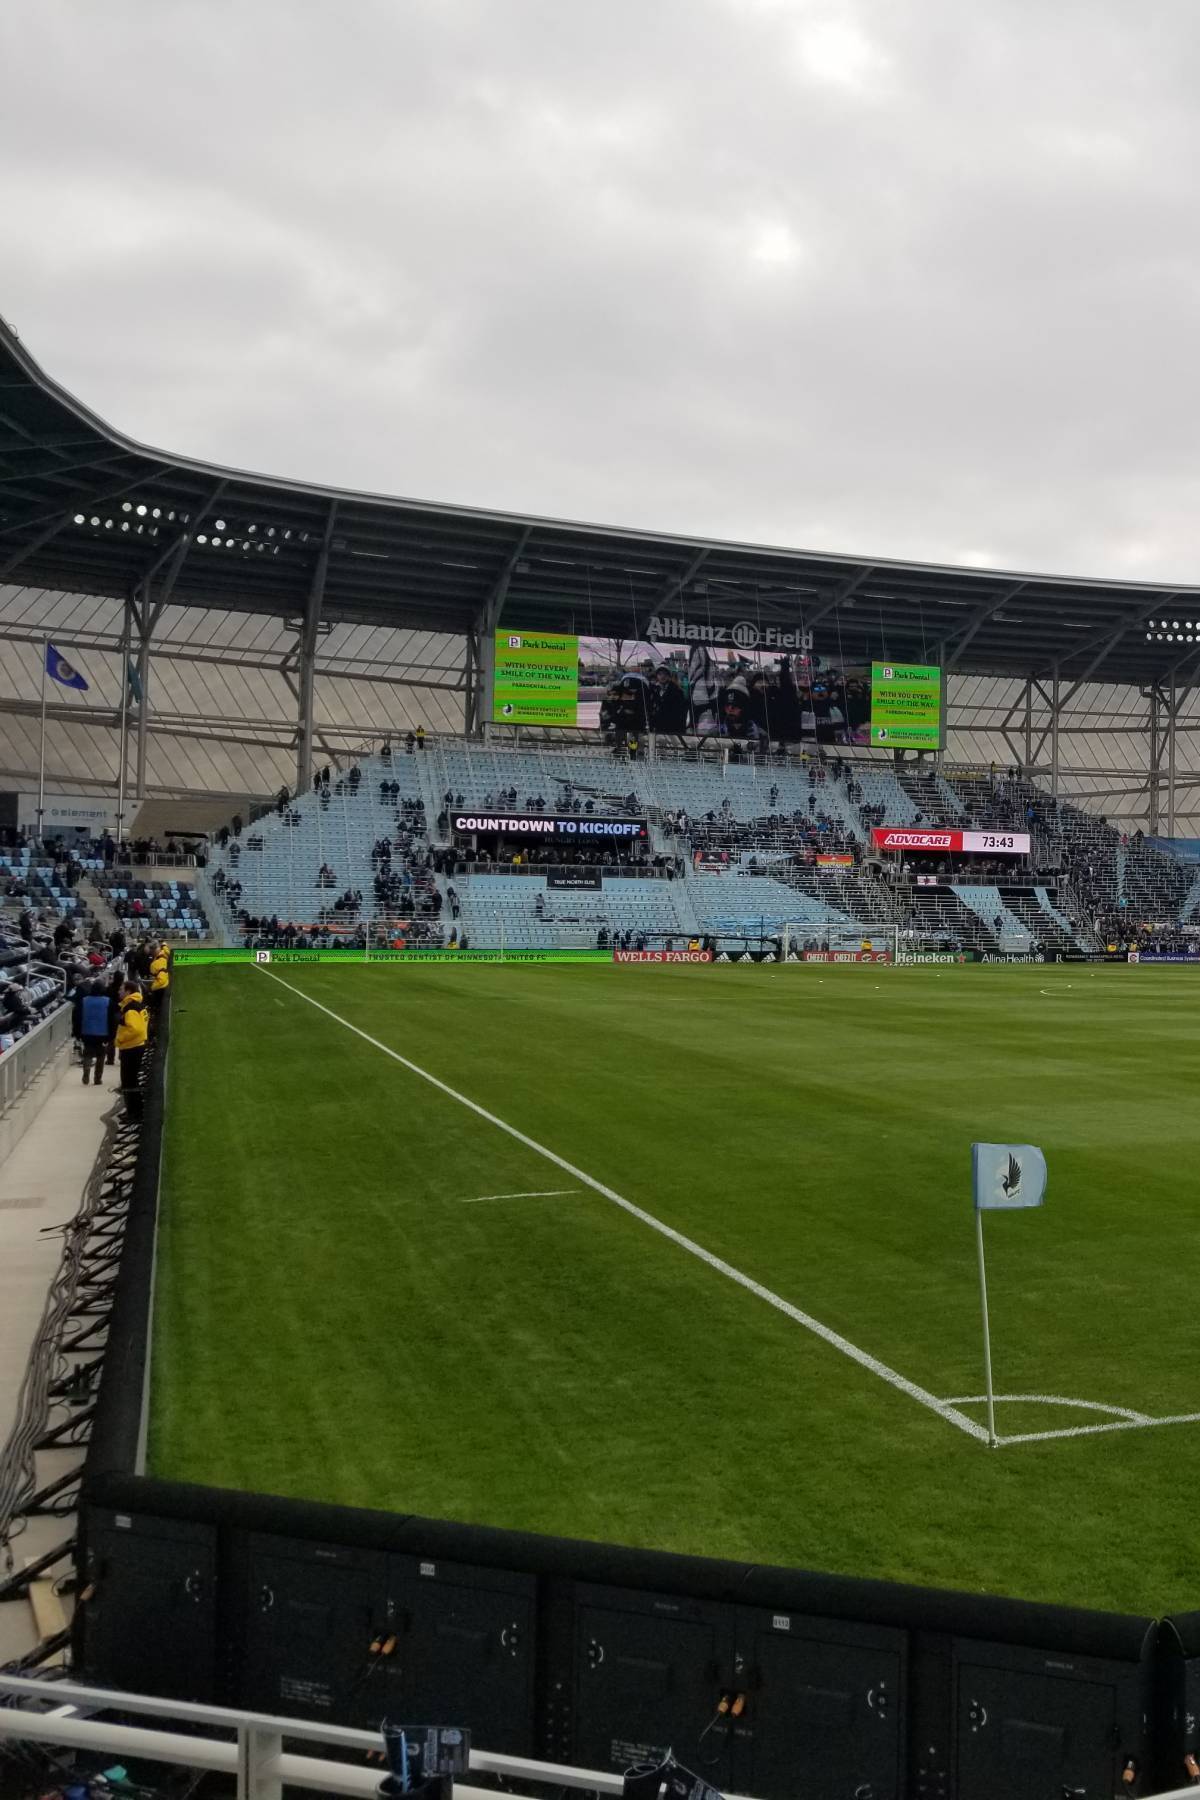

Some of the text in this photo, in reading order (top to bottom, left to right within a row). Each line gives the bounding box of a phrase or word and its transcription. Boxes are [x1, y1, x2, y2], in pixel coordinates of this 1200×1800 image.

[646, 616, 813, 650] Allianz Field
[523, 639, 539, 649] Park
[541, 641, 566, 651] Dental
[505, 661, 525, 669] WITH
[501, 669, 523, 677] SMILE
[537, 672, 554, 680] THE
[894, 671, 908, 680] Park
[909, 672, 930, 681] Dental
[880, 690, 897, 698] WITH
[897, 691, 911, 699] YOU
[906, 699, 920, 707] THE
[61, 808, 108, 818] element
[456, 817, 554, 832] COUNTDOWN
[557, 822, 577, 832] TO
[885, 833, 1014, 848] ADVOCARE 73:43
[272, 954, 291, 962] Park
[292, 953, 320, 962] Dental
[617, 952, 710, 962] WELLS FARGO
[897, 953, 954, 963] Heineken
